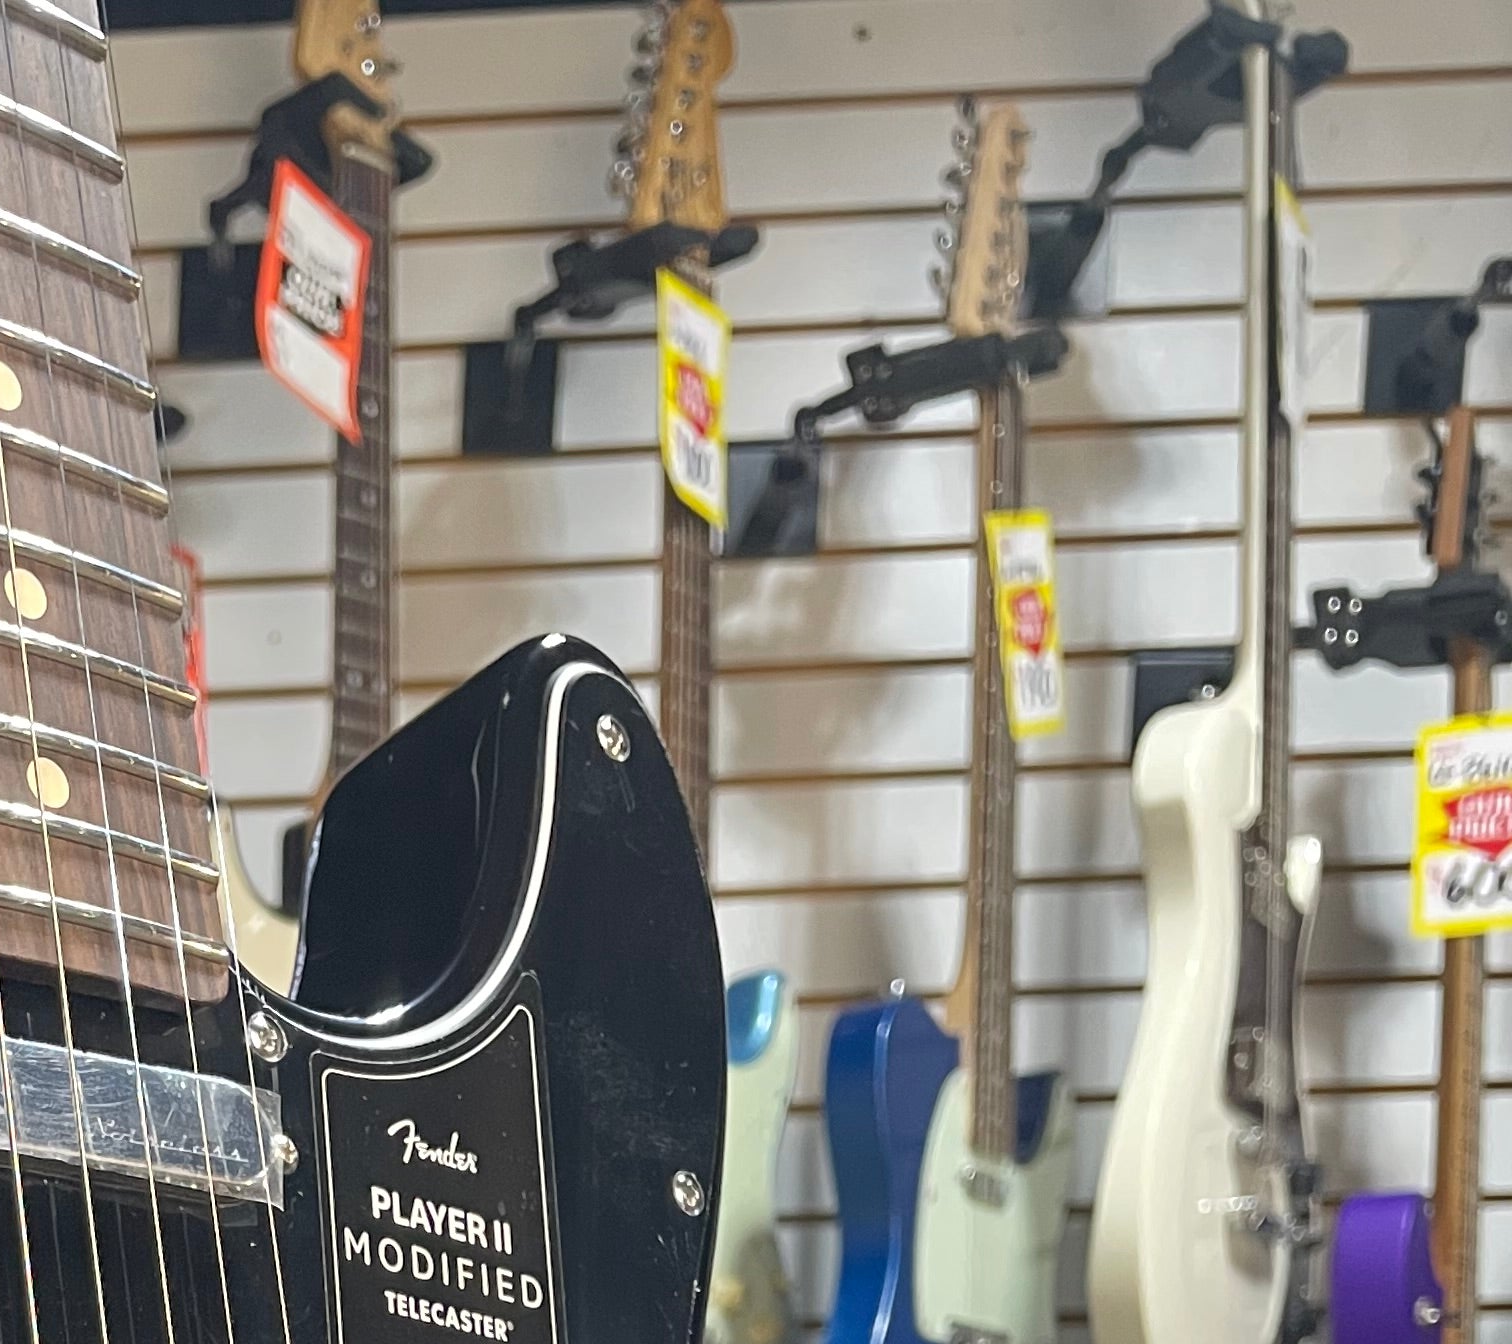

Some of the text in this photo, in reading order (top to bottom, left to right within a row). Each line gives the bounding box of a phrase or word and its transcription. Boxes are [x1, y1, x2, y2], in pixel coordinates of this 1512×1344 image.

[387, 1118, 478, 1174] Fender
[371, 1185, 513, 1255] PLAYER II
[343, 1226, 544, 1309] MODIFIED
